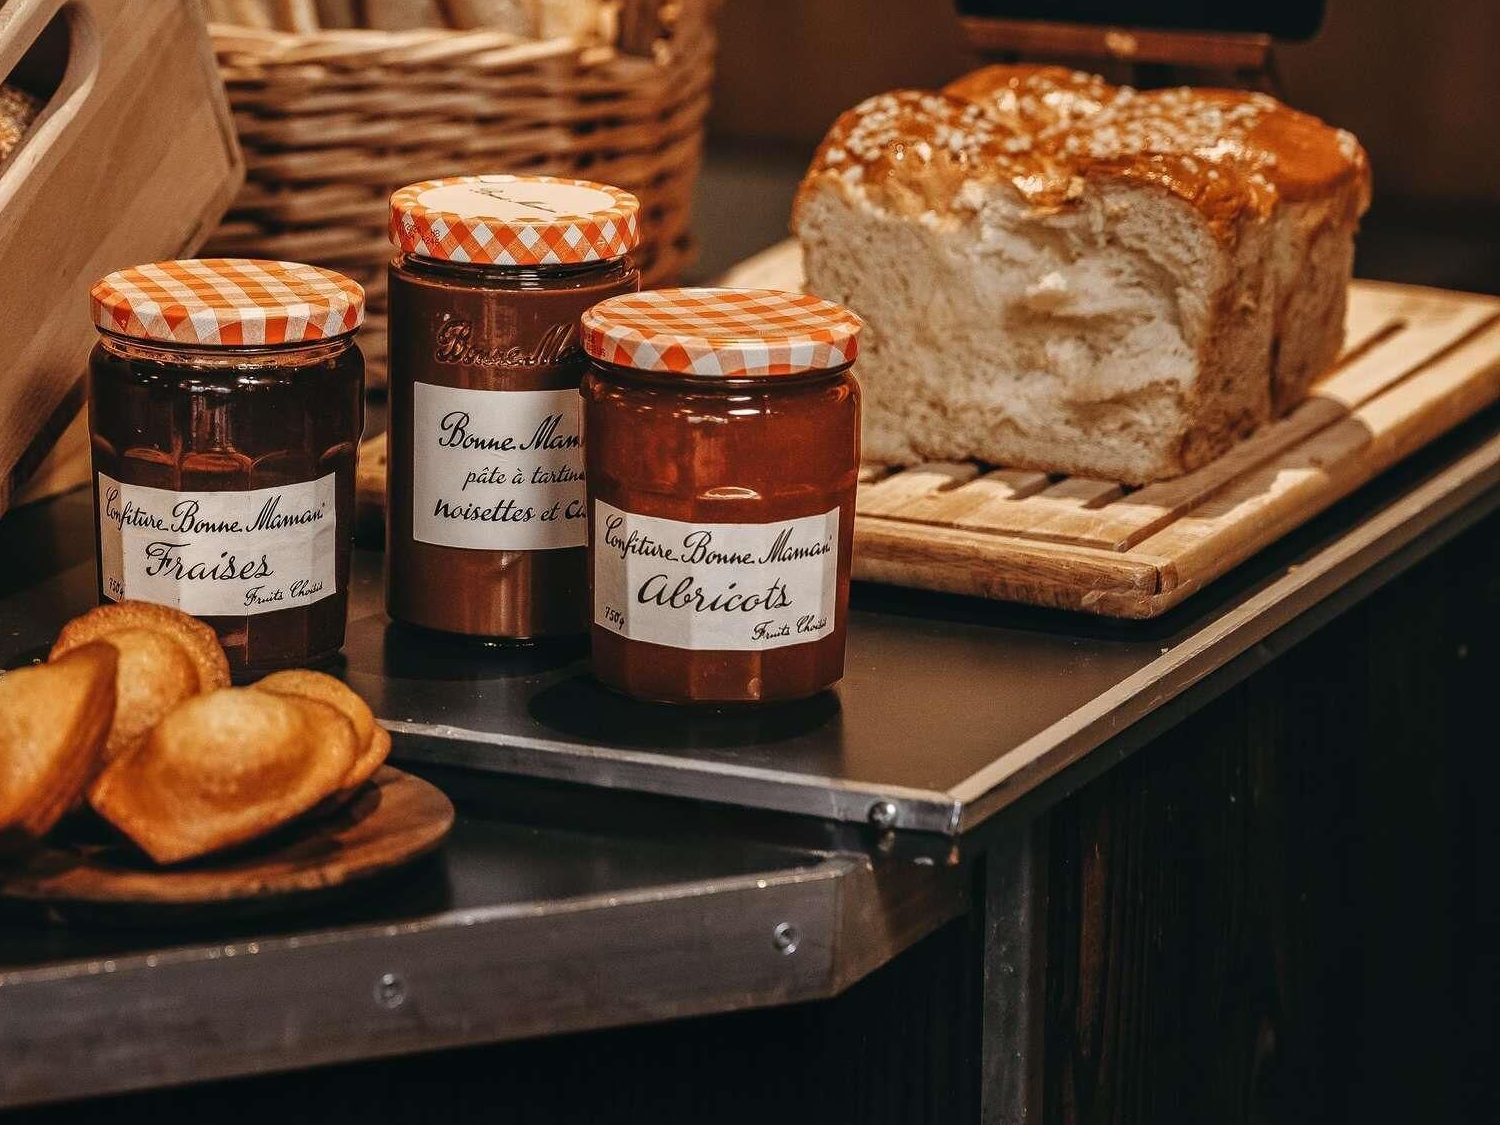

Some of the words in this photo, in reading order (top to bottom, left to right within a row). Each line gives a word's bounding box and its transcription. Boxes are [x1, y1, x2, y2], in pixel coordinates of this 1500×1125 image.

[438, 411, 516, 451] Bonne
[462, 466, 506, 491] pâte
[511, 467, 525, 484] à
[106, 486, 168, 531] Confiture
[171, 500, 242, 533] Bonne
[246, 494, 324, 532] Maman
[540, 501, 560, 522] et
[605, 513, 678, 559] Confiture
[681, 530, 755, 565] Bonne
[759, 526, 831, 564] Maman
[145, 541, 274, 581] Fraises
[244, 585, 283, 606] Fruits
[637, 574, 792, 612] Abricots
[604, 606, 625, 630] 750g
[751, 619, 790, 641] Fruits
